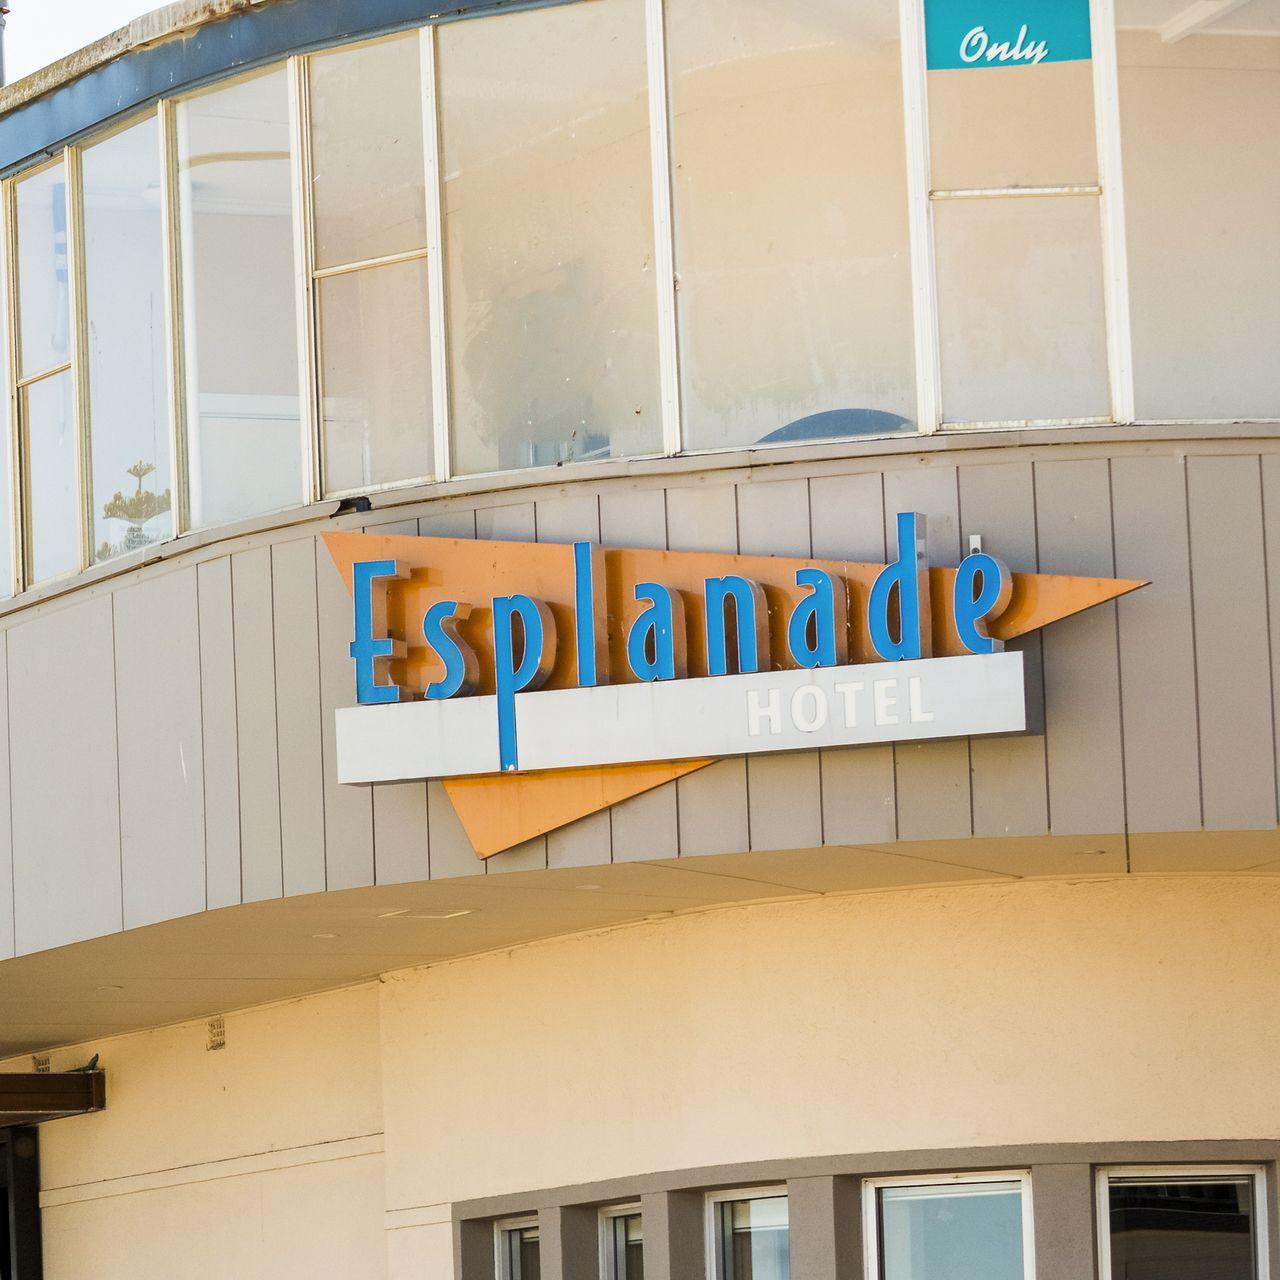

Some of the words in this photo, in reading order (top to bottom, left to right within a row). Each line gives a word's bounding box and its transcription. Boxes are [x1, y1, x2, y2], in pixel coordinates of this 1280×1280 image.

[959, 24, 1049, 64] Only
[349, 512, 1007, 772] Esplanade
[746, 676, 935, 736] HOTEL
